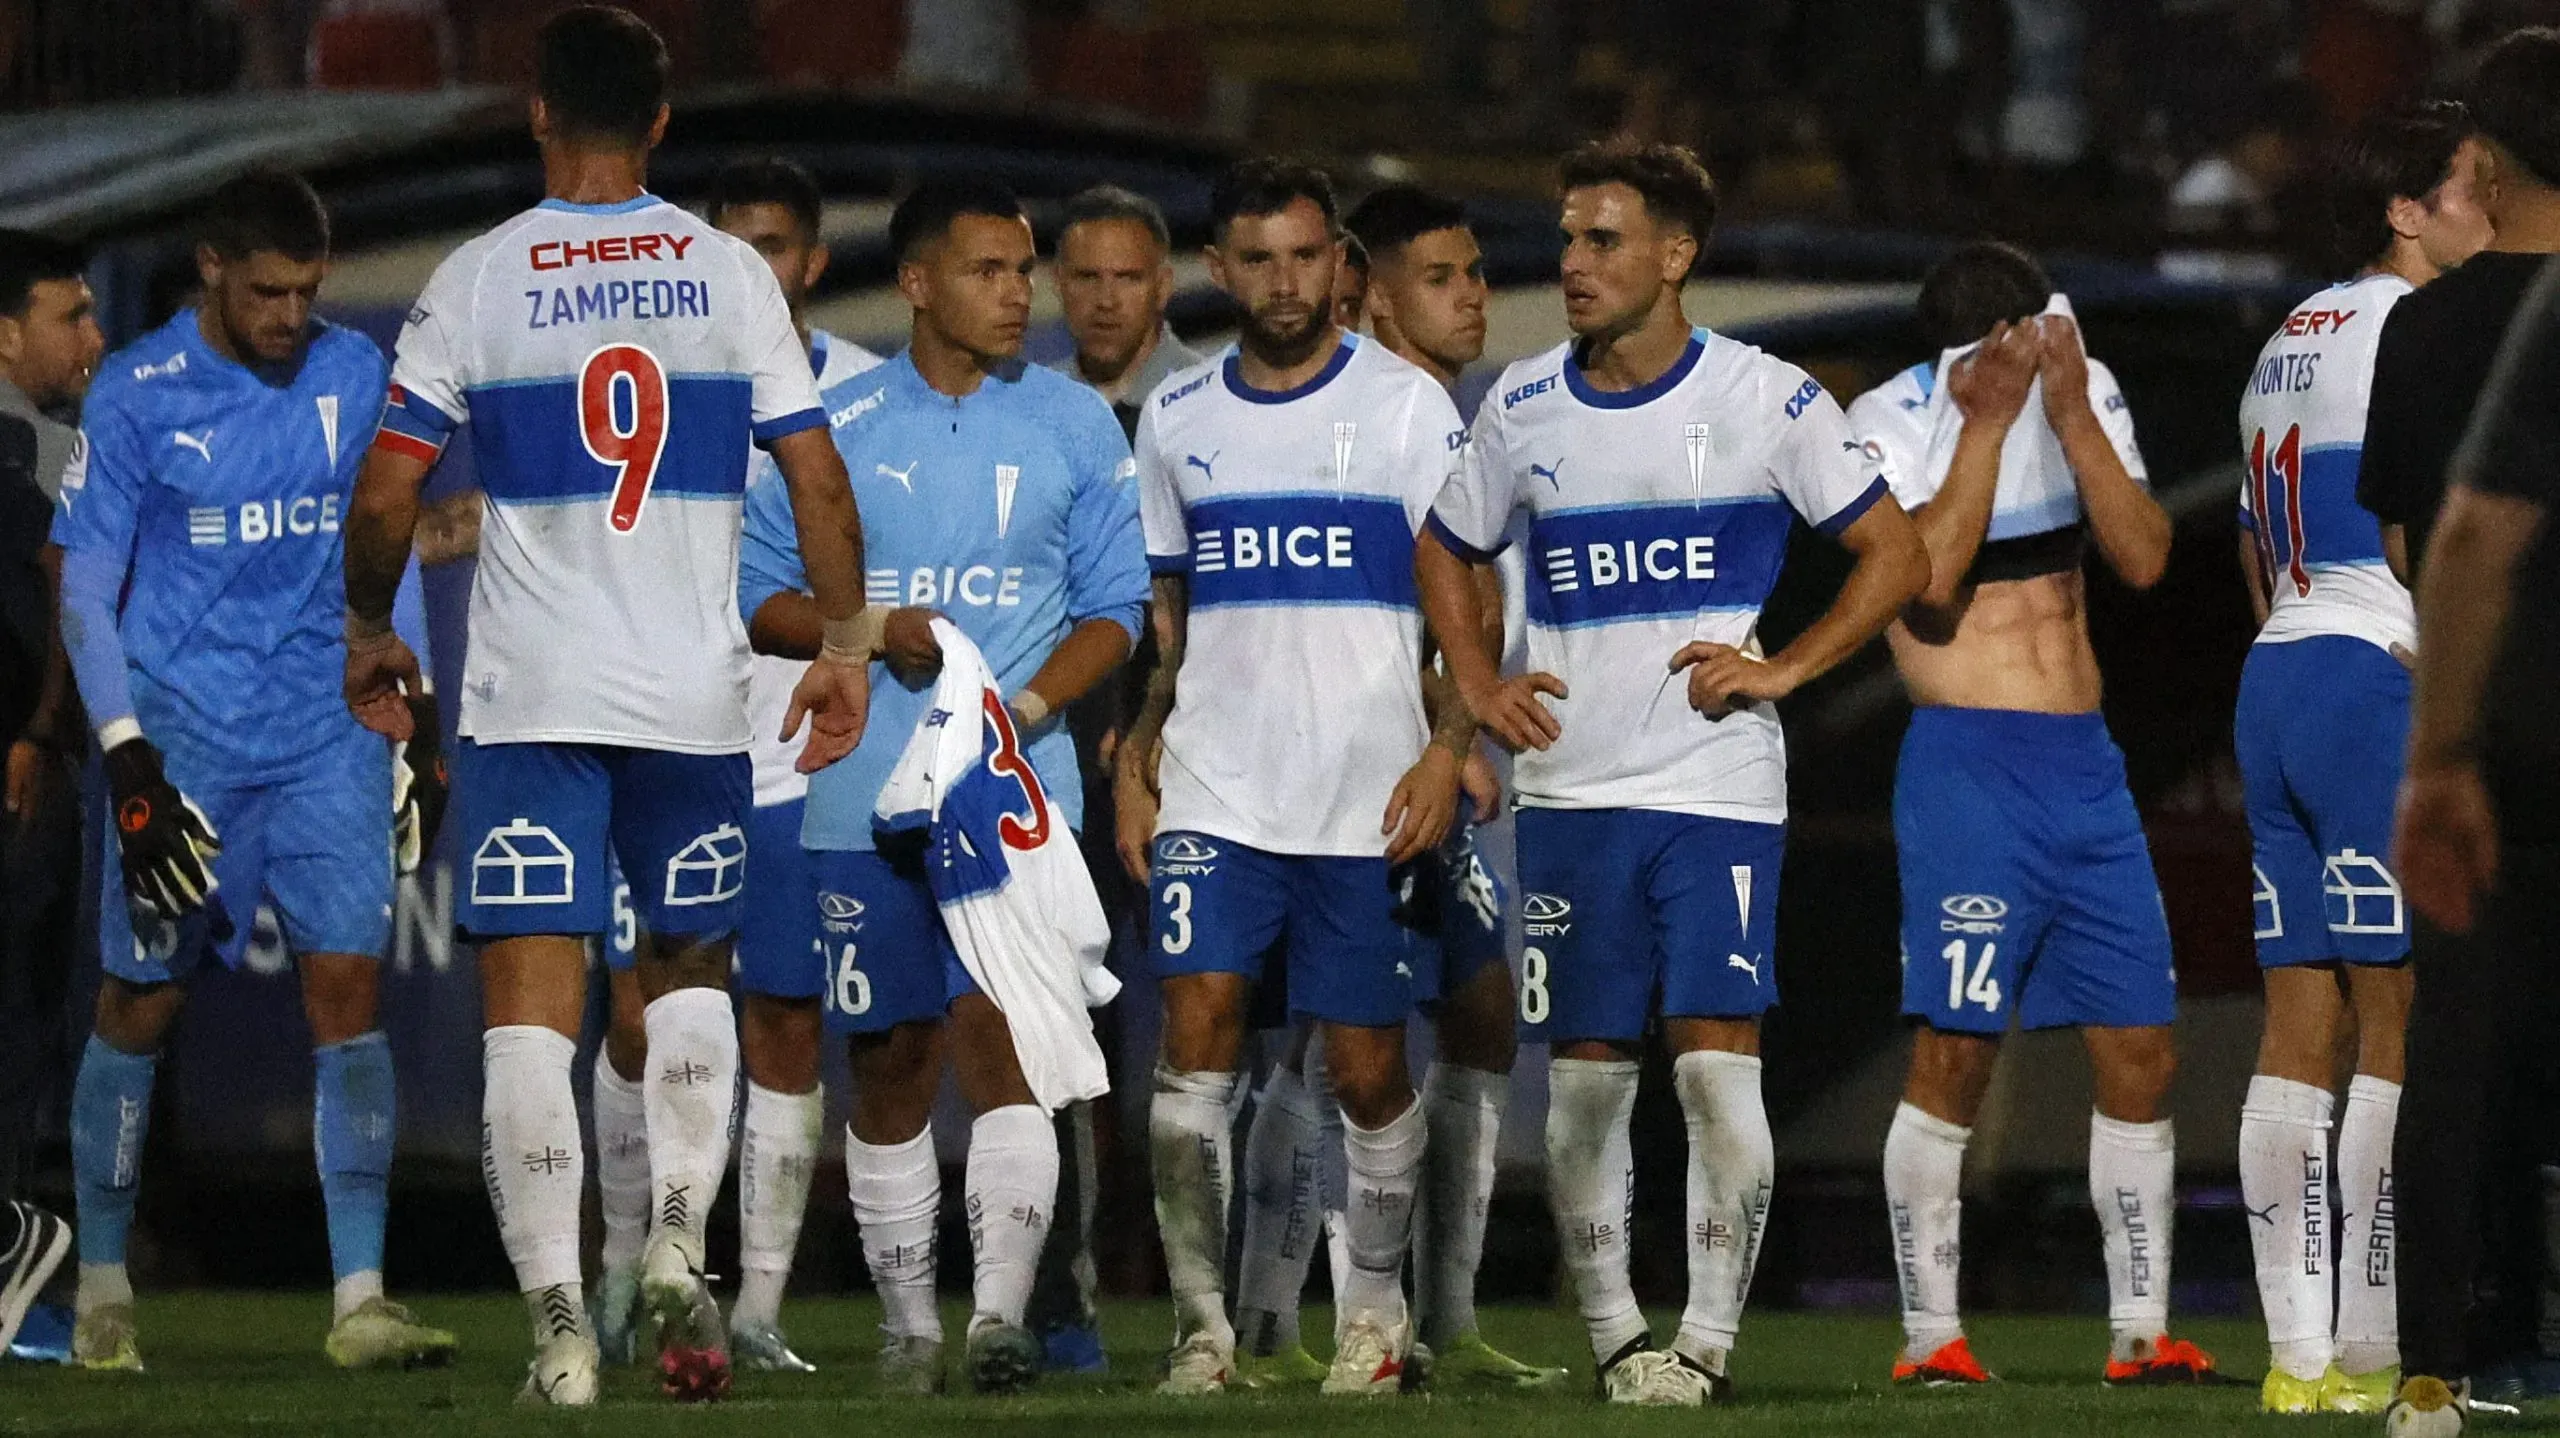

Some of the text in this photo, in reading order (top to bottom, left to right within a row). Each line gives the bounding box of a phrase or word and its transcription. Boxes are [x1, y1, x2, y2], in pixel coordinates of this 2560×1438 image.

[529, 234, 694, 271] CHERY
[524, 280, 710, 329] ZAMPEDRI
[2283, 309, 2357, 337] ERY
[1504, 371, 1560, 410] 1XBET
[2251, 352, 2321, 397] MONTES
[577, 342, 669, 536] 9
[239, 493, 341, 543] BICE
[2250, 422, 2314, 599] 11
[1234, 526, 1353, 569] BICE
[1588, 536, 1716, 586] BICE
[909, 565, 1024, 607] BICE
[983, 687, 1050, 851] 3
[613, 884, 637, 953] 5
[1161, 881, 1192, 955] 3
[1525, 922, 1572, 937] ERY
[1520, 947, 1550, 1025] 8
[1941, 939, 2002, 1013] 14
